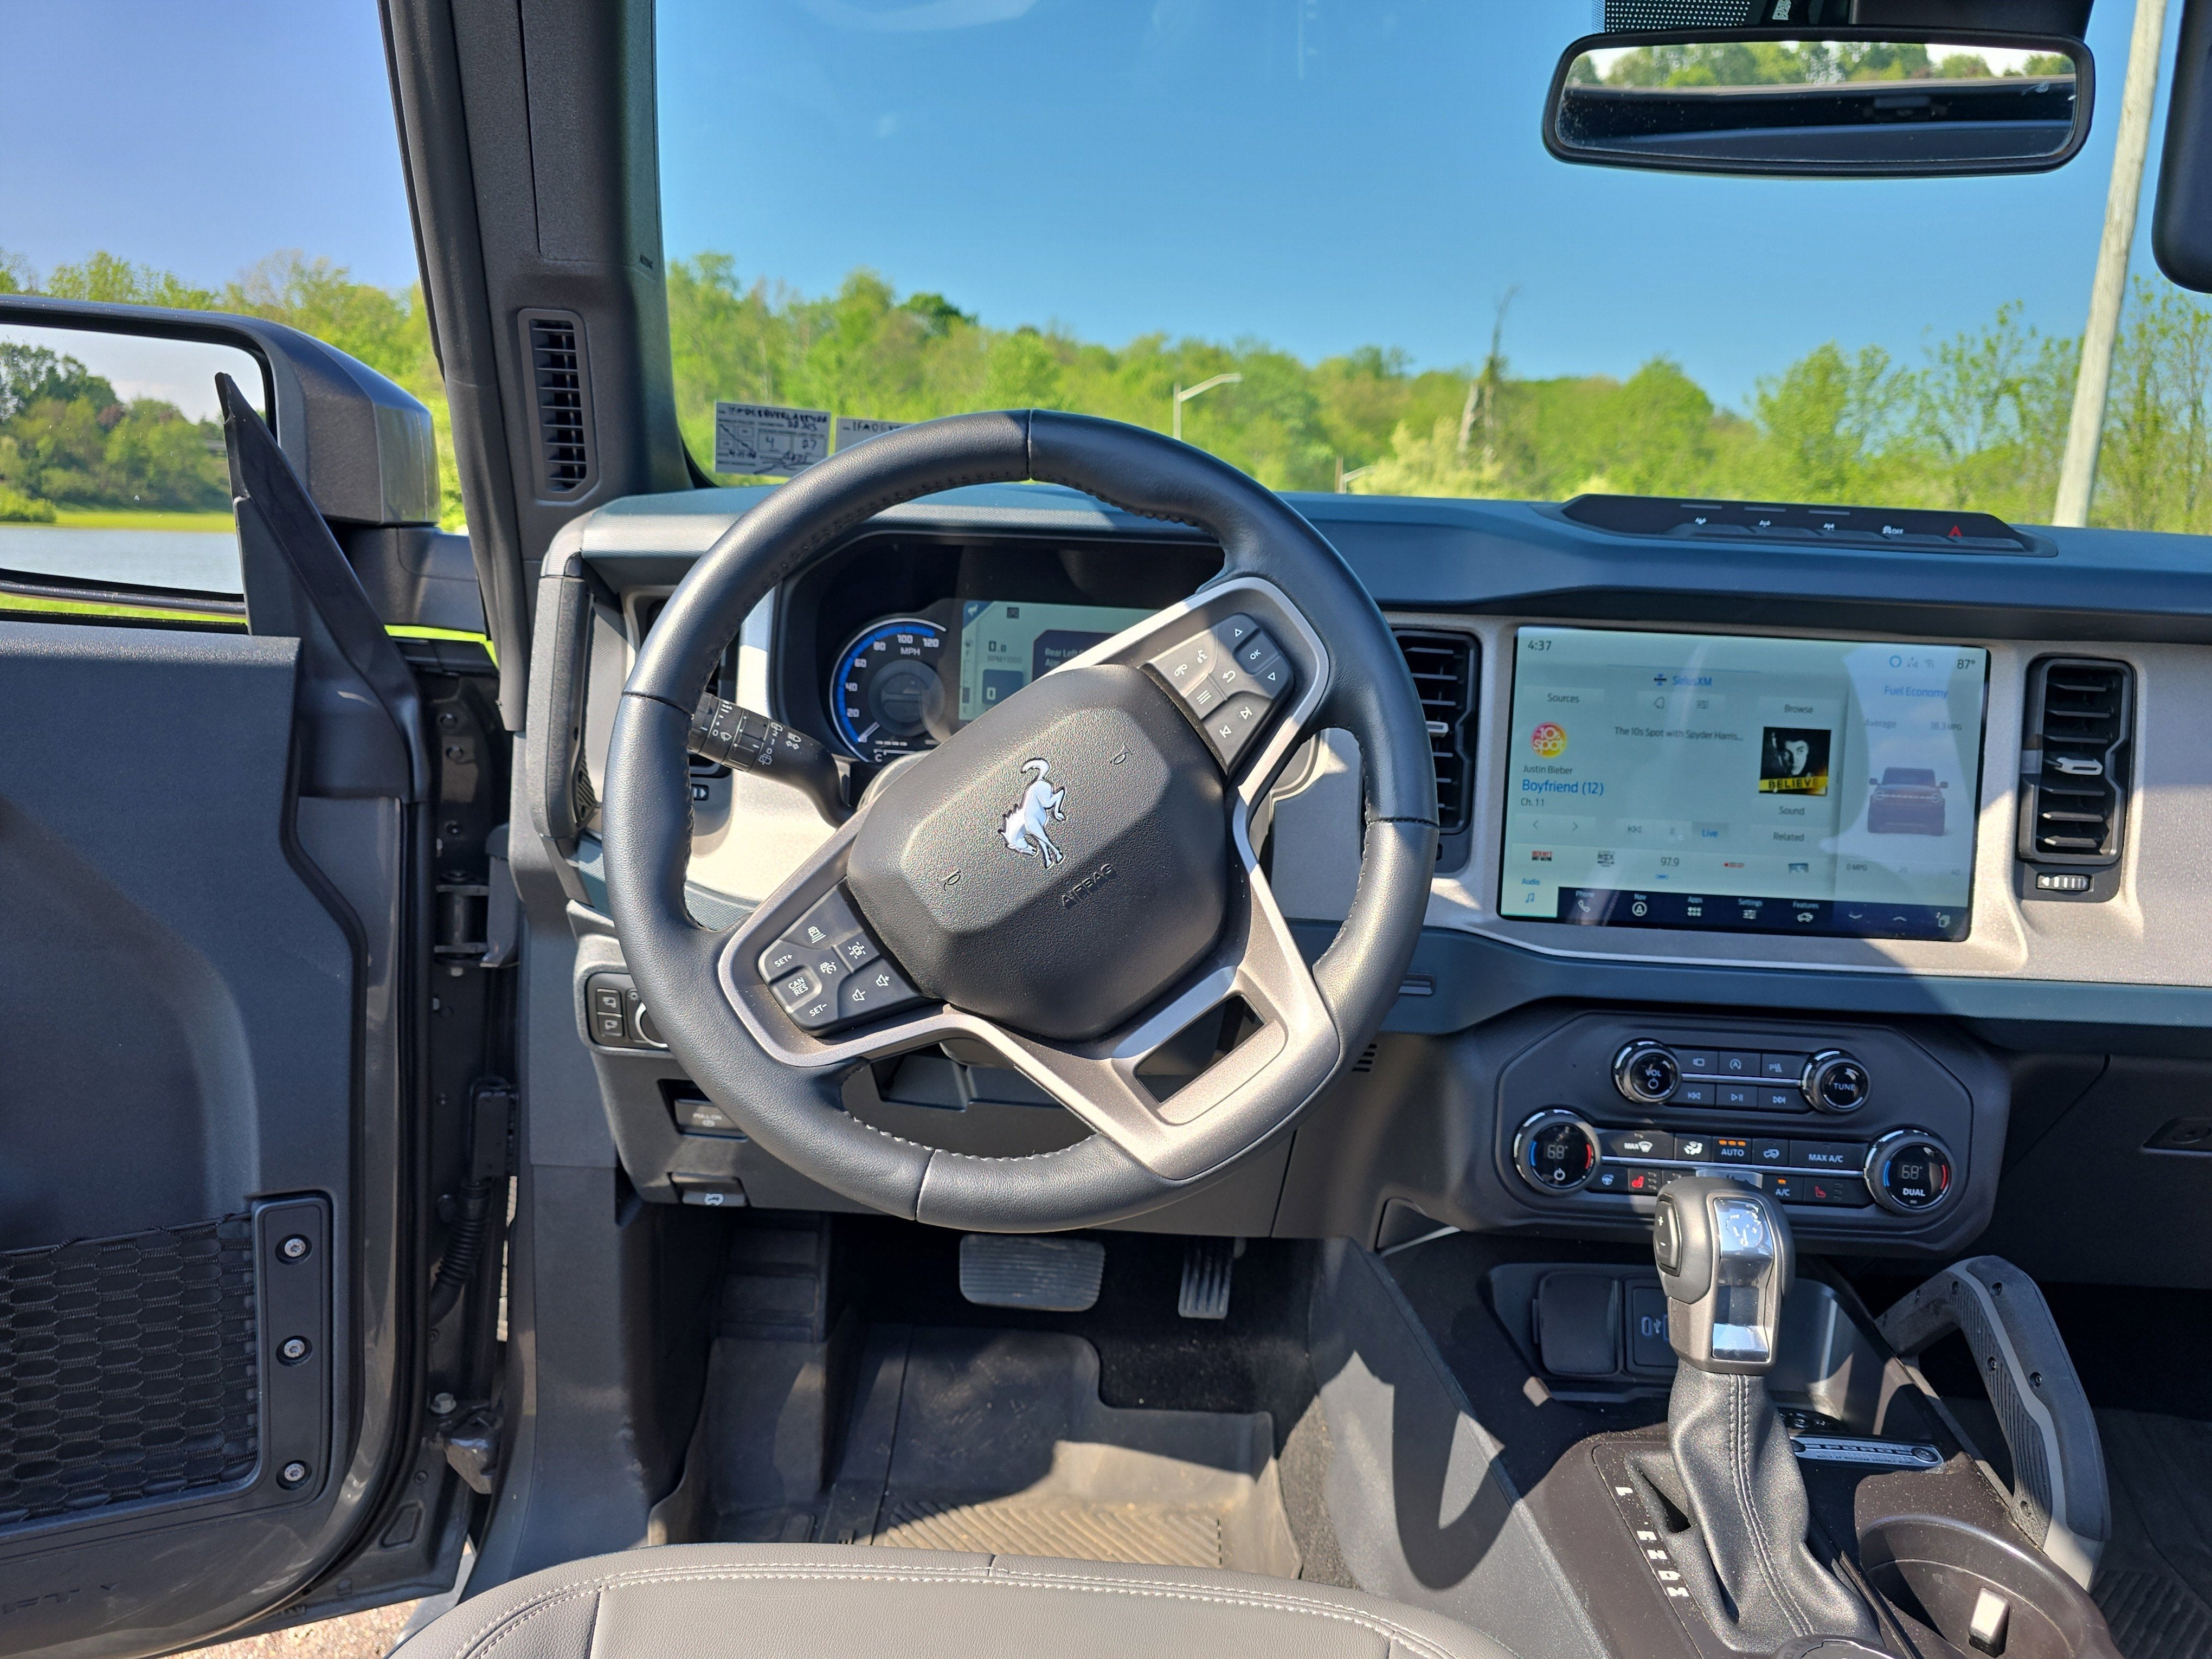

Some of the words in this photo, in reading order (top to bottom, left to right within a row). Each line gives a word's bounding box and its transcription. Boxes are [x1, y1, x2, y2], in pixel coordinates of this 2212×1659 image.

[897, 634, 914, 644] 100
[923, 638, 940, 648] 120
[873, 641, 886, 651] 80
[1527, 640, 1552, 652] 4:37
[900, 647, 921, 656] MPH
[1250, 649, 1262, 660] OK
[854, 658, 867, 668] 60
[1957, 658, 1976, 670] 87°
[845, 683, 858, 692] 40
[1884, 686, 1904, 696] Fuel
[1906, 686, 1948, 699] Economy
[987, 687, 996, 700] 0
[1547, 693, 1579, 704] Sources
[846, 709, 859, 718] 20
[1784, 704, 1814, 715] Browse
[1615, 726, 1629, 736] The
[1645, 728, 1664, 738] Spot
[1686, 730, 1713, 741] Spyder
[874, 753, 883, 762] C
[1523, 764, 1546, 774] Justin
[1547, 765, 1573, 775] Bieber
[1522, 779, 1579, 794] Boyfriend
[1581, 782, 1604, 796] (12)
[1520, 798, 1533, 807] Ch.
[1535, 798, 1545, 807] 11
[1779, 805, 1805, 816] Sound
[1702, 828, 1719, 838] Live
[1773, 831, 1805, 842] Related
[1660, 857, 1680, 867] 97.9
[1062, 863, 1117, 909] AIRBAG
[1521, 877, 1541, 886] Audio
[1634, 893, 1647, 901] Nav
[774, 954, 793, 967] SET+
[788, 977, 806, 991] CAN
[794, 984, 809, 996] RES
[809, 1004, 827, 1017] SET-
[1645, 1069, 1662, 1078] VOL
[1833, 1083, 1857, 1092] TUNE
[1547, 1144, 1568, 1160] 68°
[1720, 1148, 1745, 1157] AUTO
[1808, 1153, 1828, 1162] MAX
[1829, 1155, 1844, 1164] A/C
[1901, 1165, 1923, 1180] 68°
[1775, 1188, 1791, 1197] A/C
[1902, 1187, 1926, 1197] DUAL
[1615, 1486, 1634, 1496] P
[1647, 1549, 1668, 1560] N
[1658, 1570, 1681, 1580] D
[1667, 1587, 1690, 1597] M
